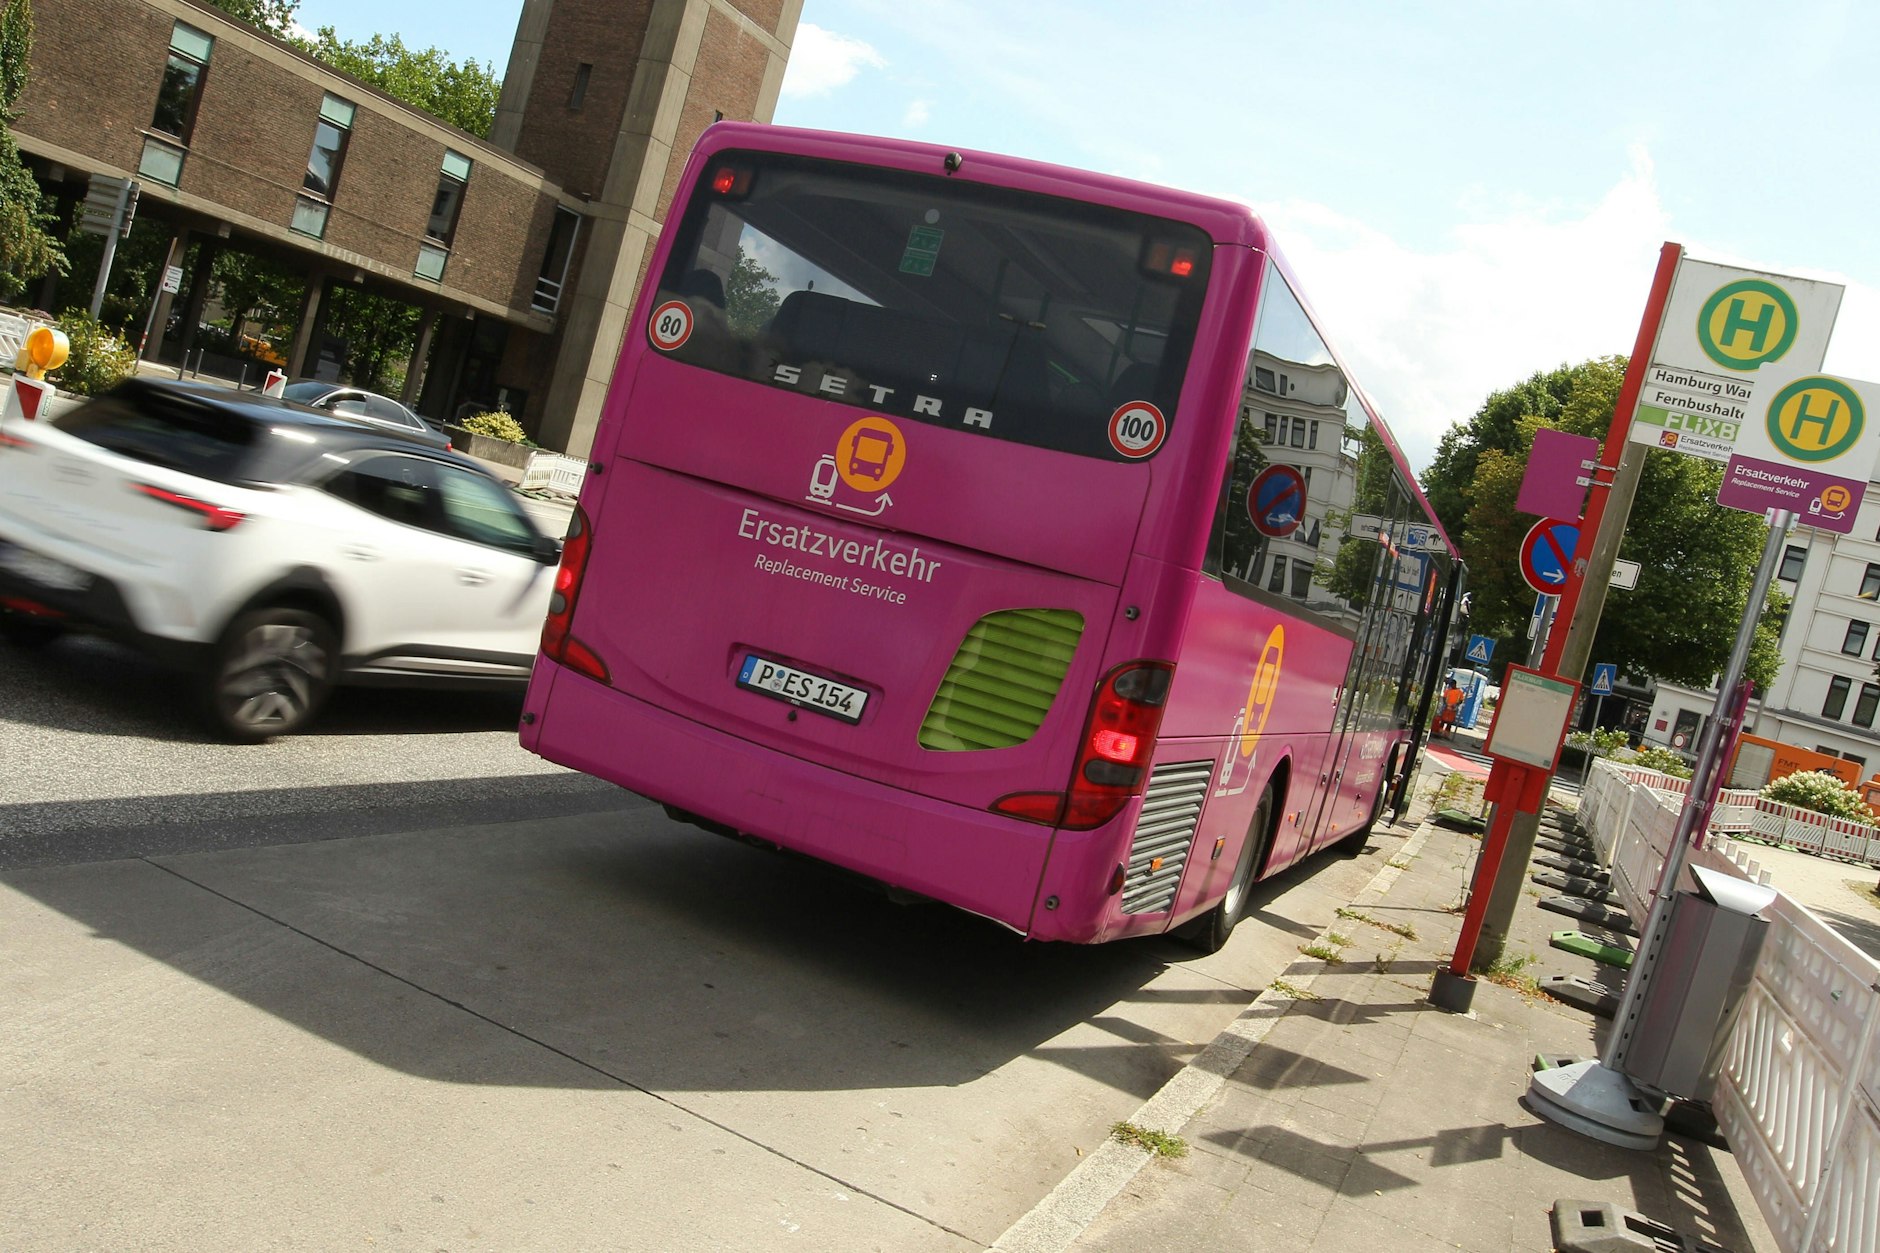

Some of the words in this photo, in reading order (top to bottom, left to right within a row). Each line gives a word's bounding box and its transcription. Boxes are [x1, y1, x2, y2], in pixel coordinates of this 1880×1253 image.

[660, 315, 682, 336] 80
[1719, 298, 1775, 352] H
[773, 364, 993, 429] SETRA
[1655, 369, 1722, 395] Hamburg
[1120, 415, 1155, 441] 100
[1789, 393, 1840, 445] H
[1731, 477, 1774, 494] Replacement
[1774, 487, 1800, 499] Service
[1734, 464, 1810, 490] Ersatzverkehr
[738, 508, 941, 583] Ersatzverkehr
[754, 553, 849, 590] Replacement
[850, 577, 907, 605] Service
